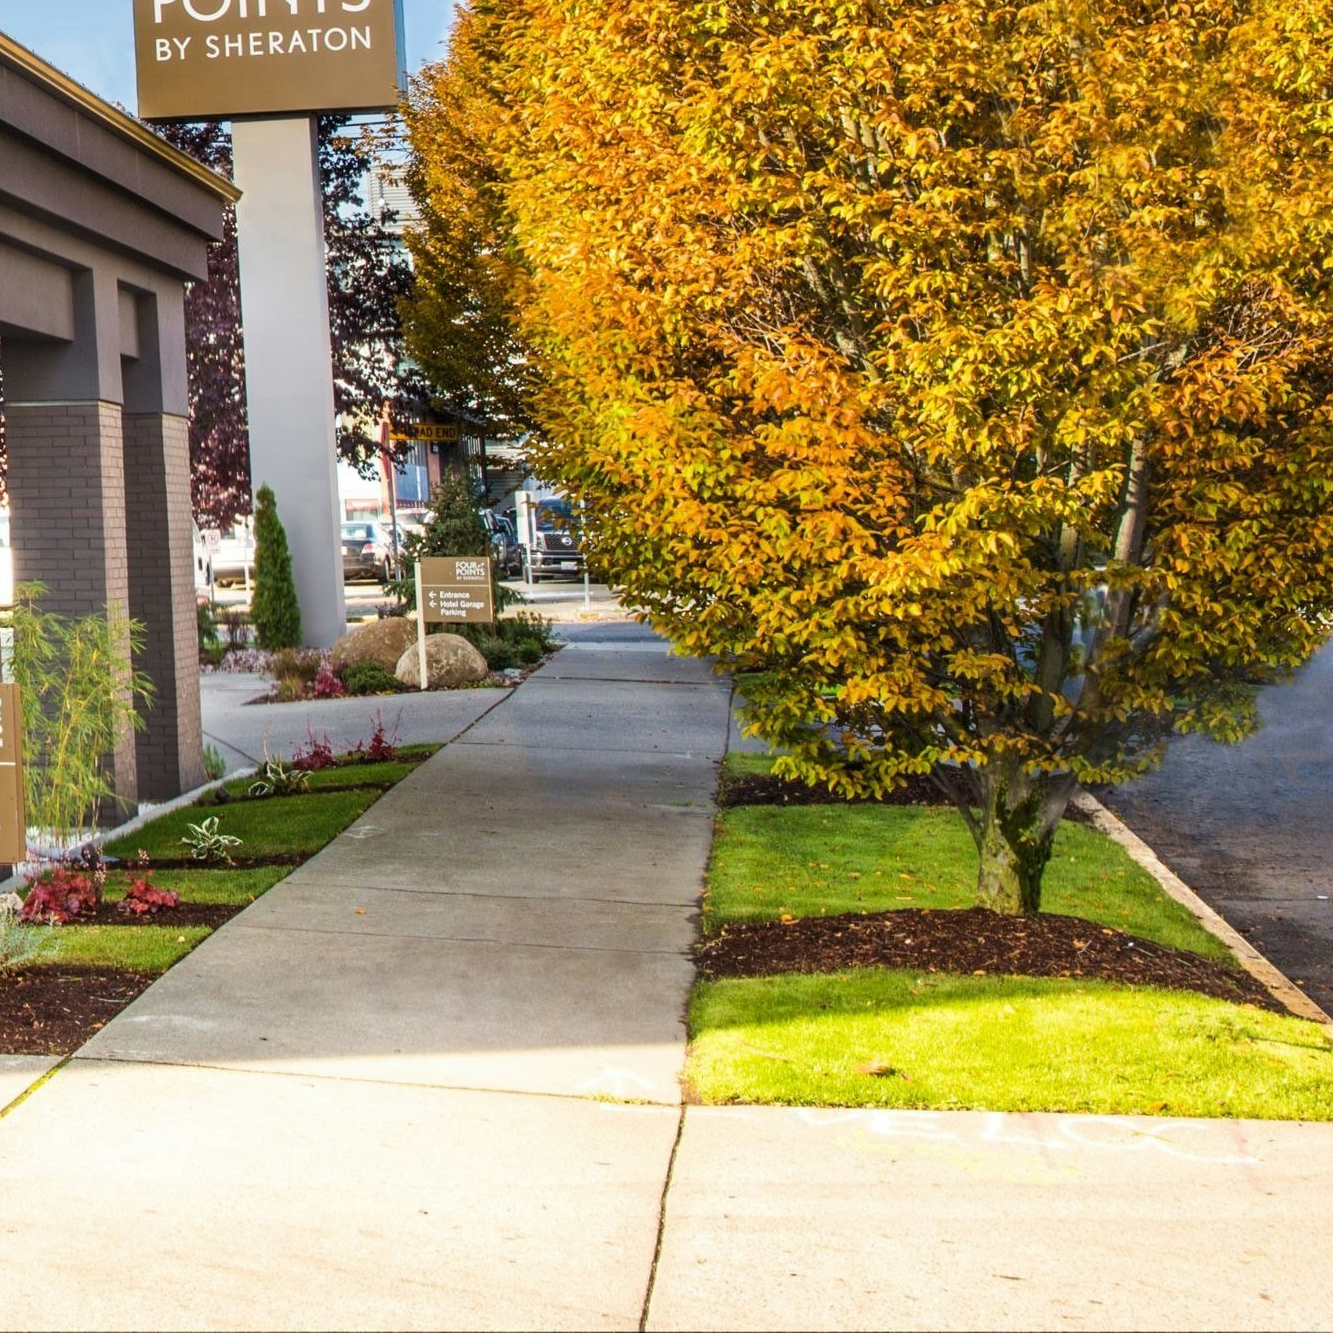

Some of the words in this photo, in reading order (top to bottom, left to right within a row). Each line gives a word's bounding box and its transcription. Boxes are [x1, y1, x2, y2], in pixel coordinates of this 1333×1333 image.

[155, 36, 191, 61] BY
[206, 26, 371, 58] SHERATON
[436, 427, 455, 439] END
[456, 568, 485, 576] POINTS
[460, 601, 484, 609] Garage
